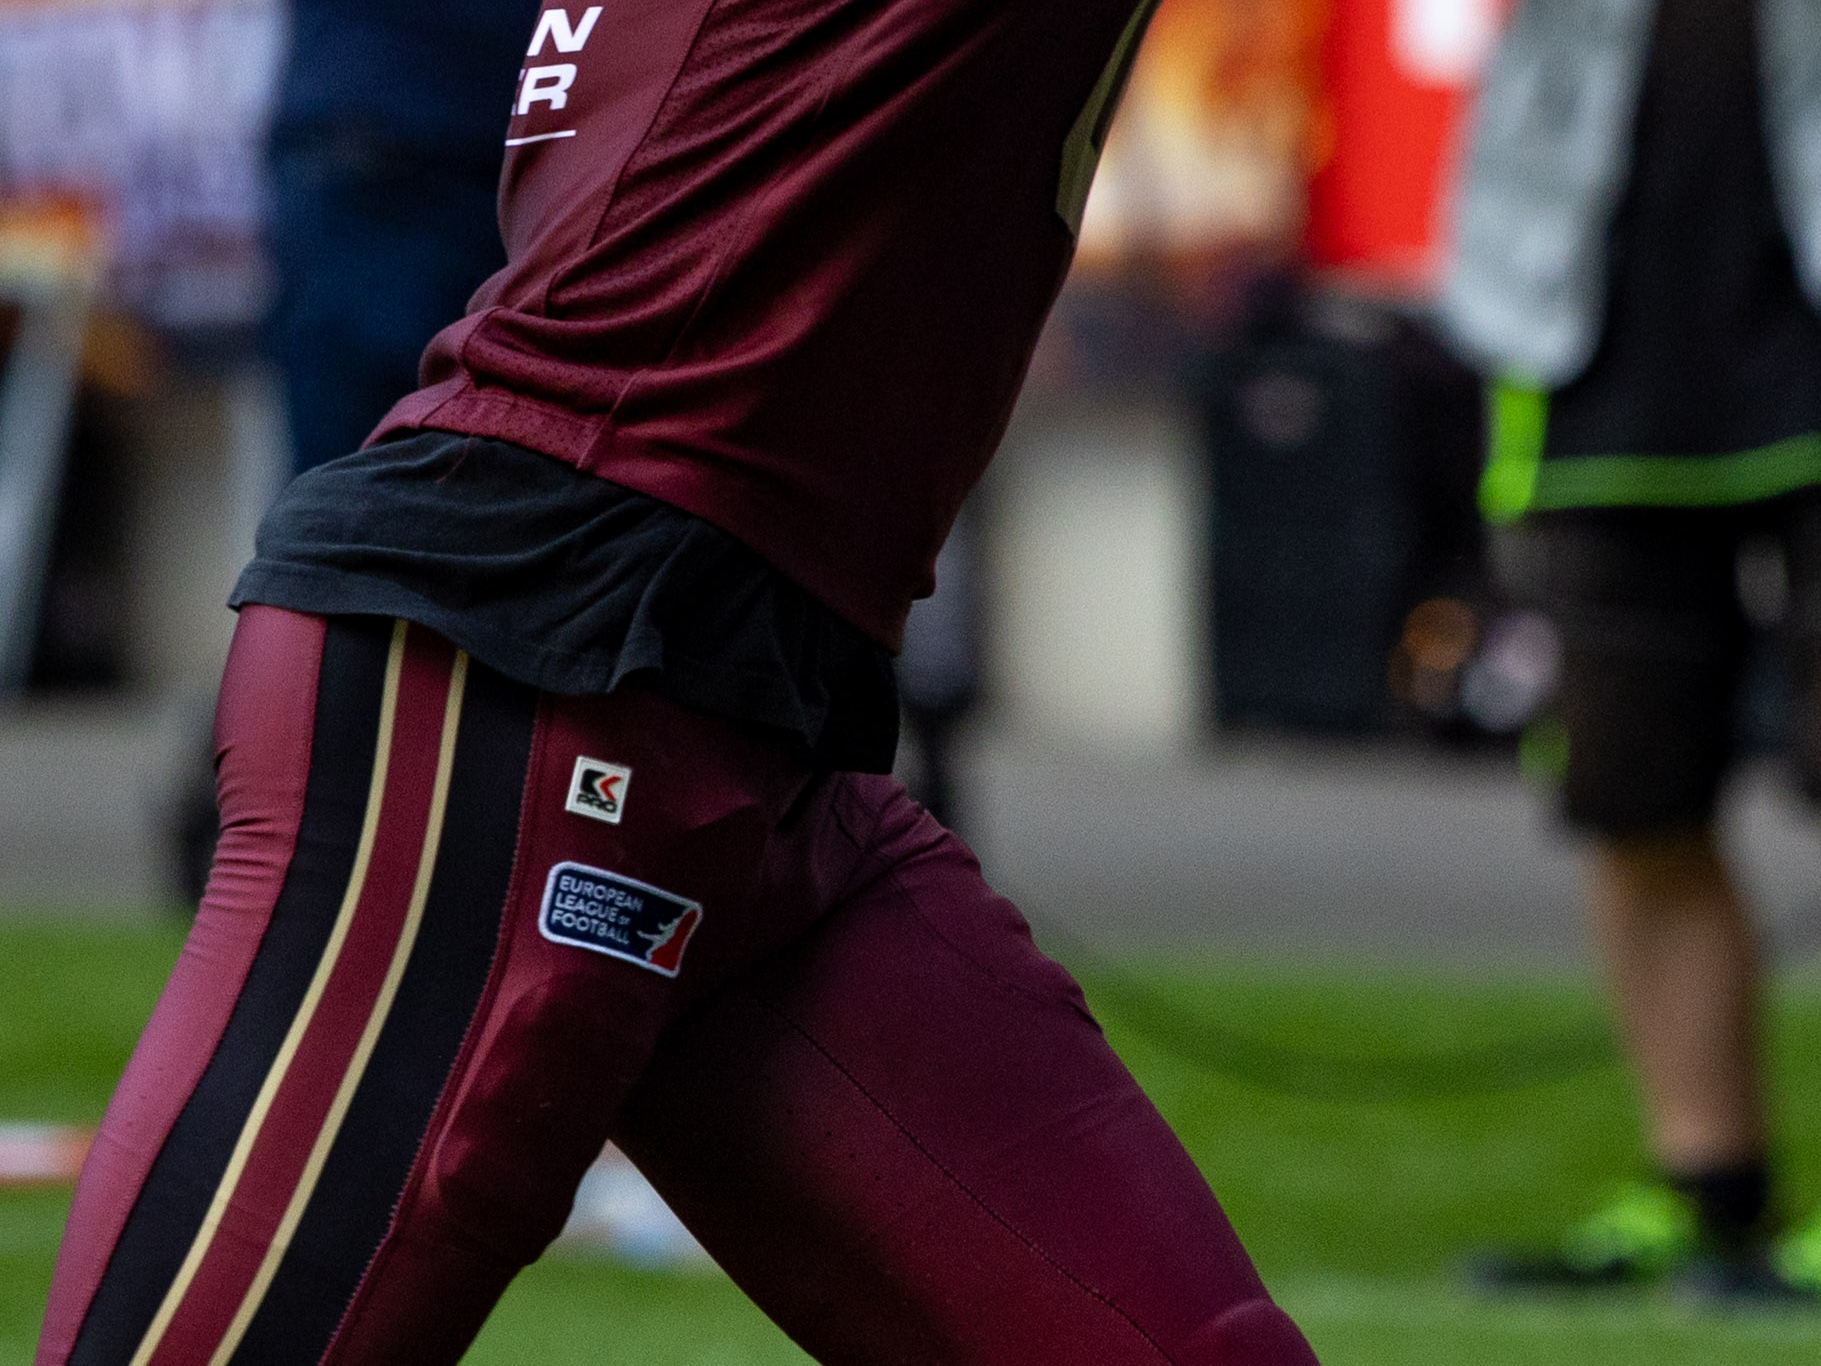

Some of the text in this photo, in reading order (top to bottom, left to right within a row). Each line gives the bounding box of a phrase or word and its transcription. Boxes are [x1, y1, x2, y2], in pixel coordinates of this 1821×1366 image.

[526, 6, 604, 57] N
[511, 63, 578, 117] R
[576, 793, 618, 814] PRO
[555, 892, 619, 924] LEAGUE
[559, 875, 645, 912] EUROPEAN
[551, 909, 630, 945] FOOTBALL
